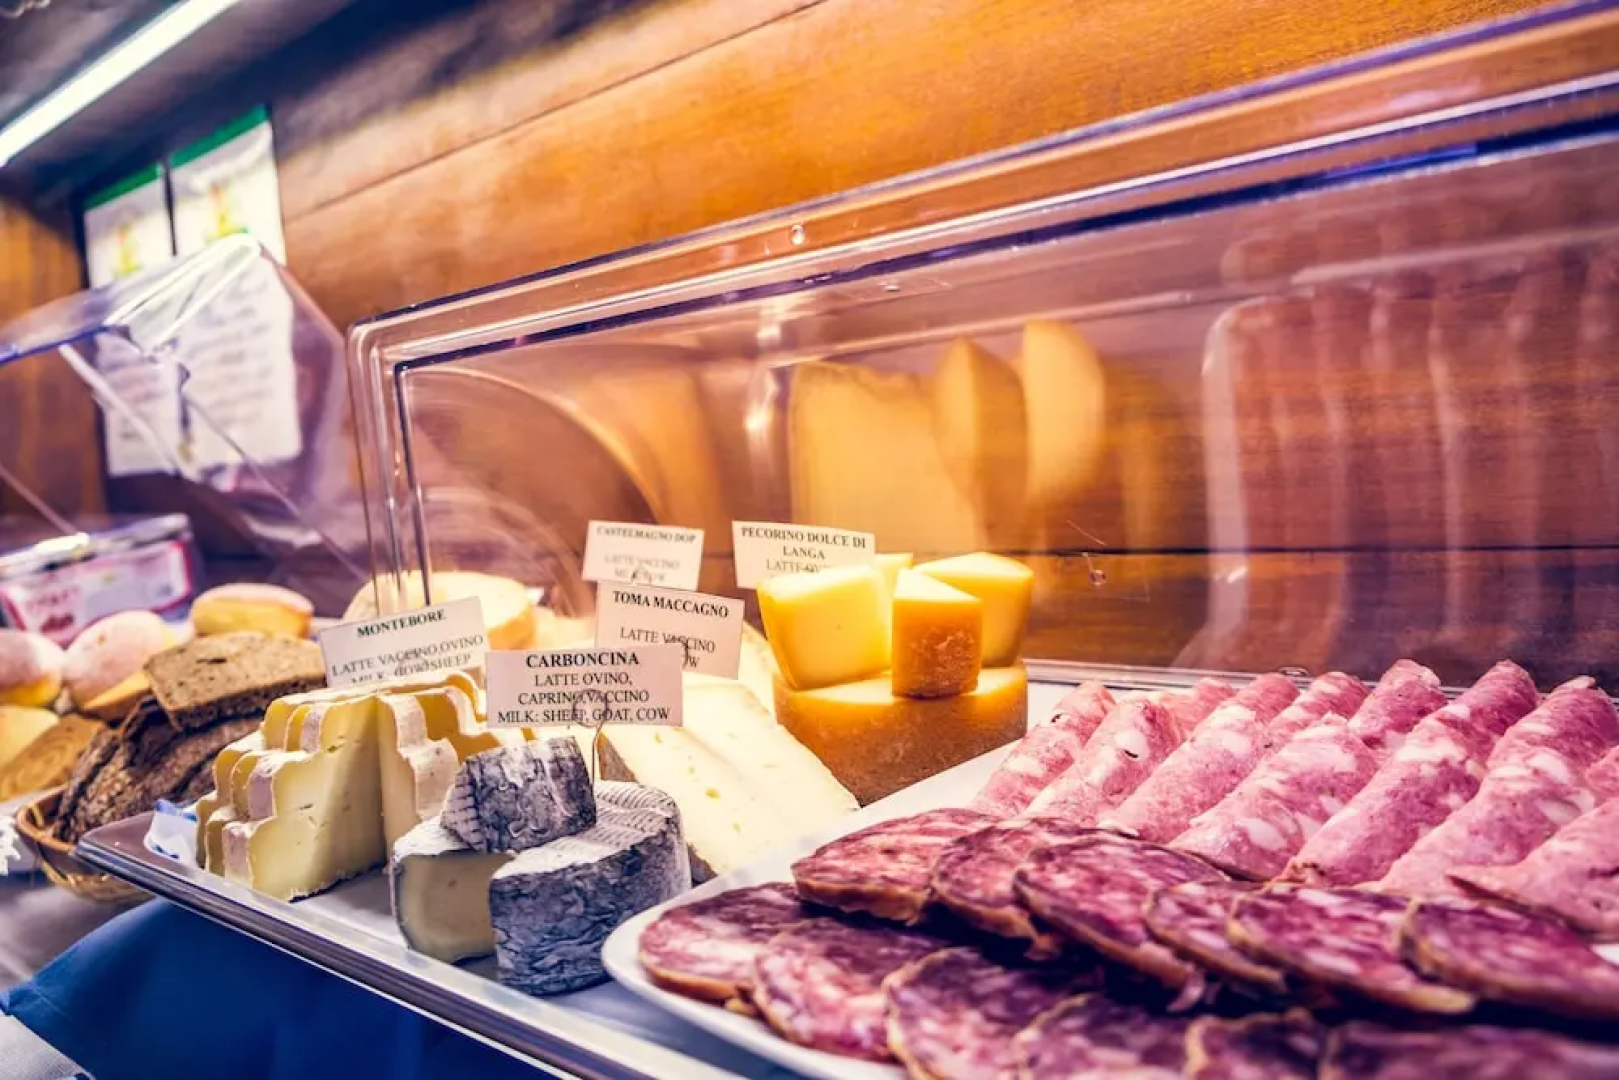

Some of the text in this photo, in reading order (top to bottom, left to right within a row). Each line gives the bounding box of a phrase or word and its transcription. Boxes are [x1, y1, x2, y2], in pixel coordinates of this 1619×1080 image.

[741, 527, 867, 548] PECORINO DOLCE DI
[783, 546, 826, 560] LANGA
[612, 590, 730, 618] TOMA MACCAGNO
[356, 608, 447, 638] MONTEBORE
[619, 627, 660, 643] LATTE
[331, 658, 376, 677] LATTE
[525, 652, 640, 668] CARBONCINA
[534, 672, 633, 687] LATTE OVINO,
[498, 710, 539, 723] MILK:
[592, 708, 633, 722] GOAT,
[636, 707, 671, 721] COW
